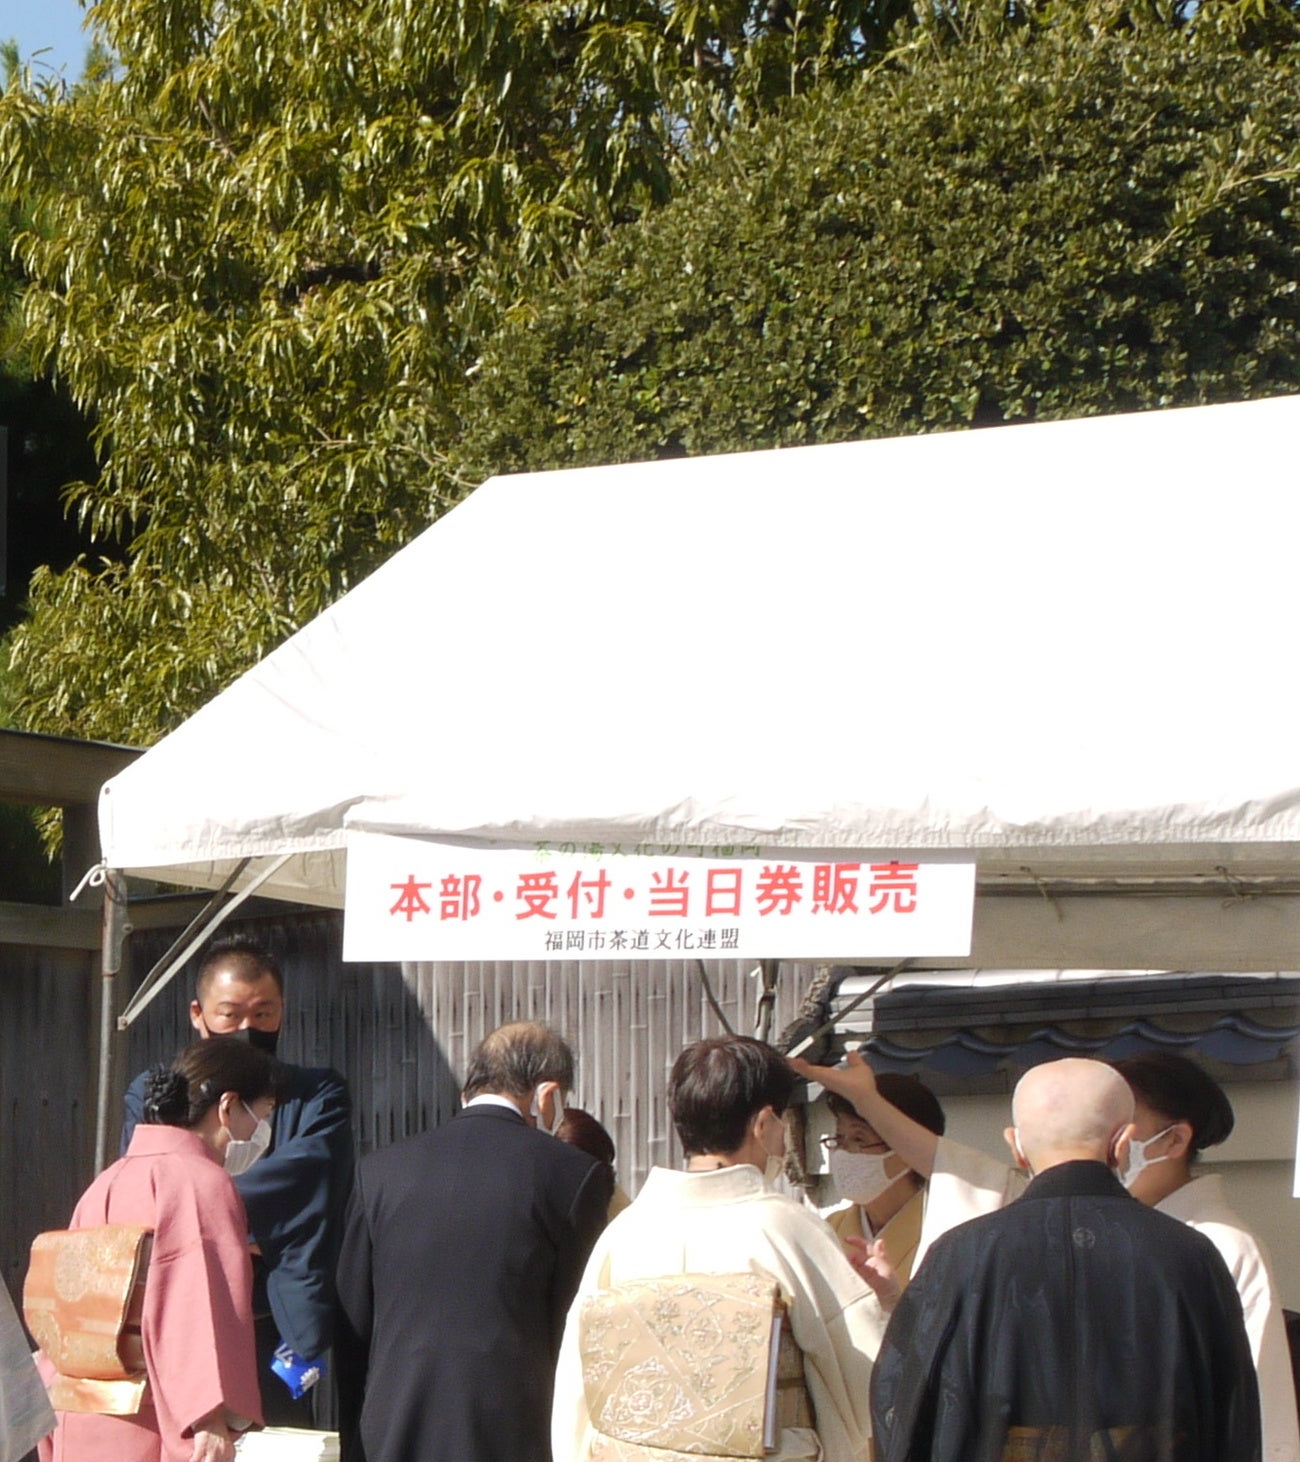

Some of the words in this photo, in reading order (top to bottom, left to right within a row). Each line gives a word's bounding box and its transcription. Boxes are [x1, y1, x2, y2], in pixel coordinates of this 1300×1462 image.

[389, 860, 920, 922] 本部・受付・当日券販売
[544, 927, 740, 952] 福岡市茶道文化連盟
